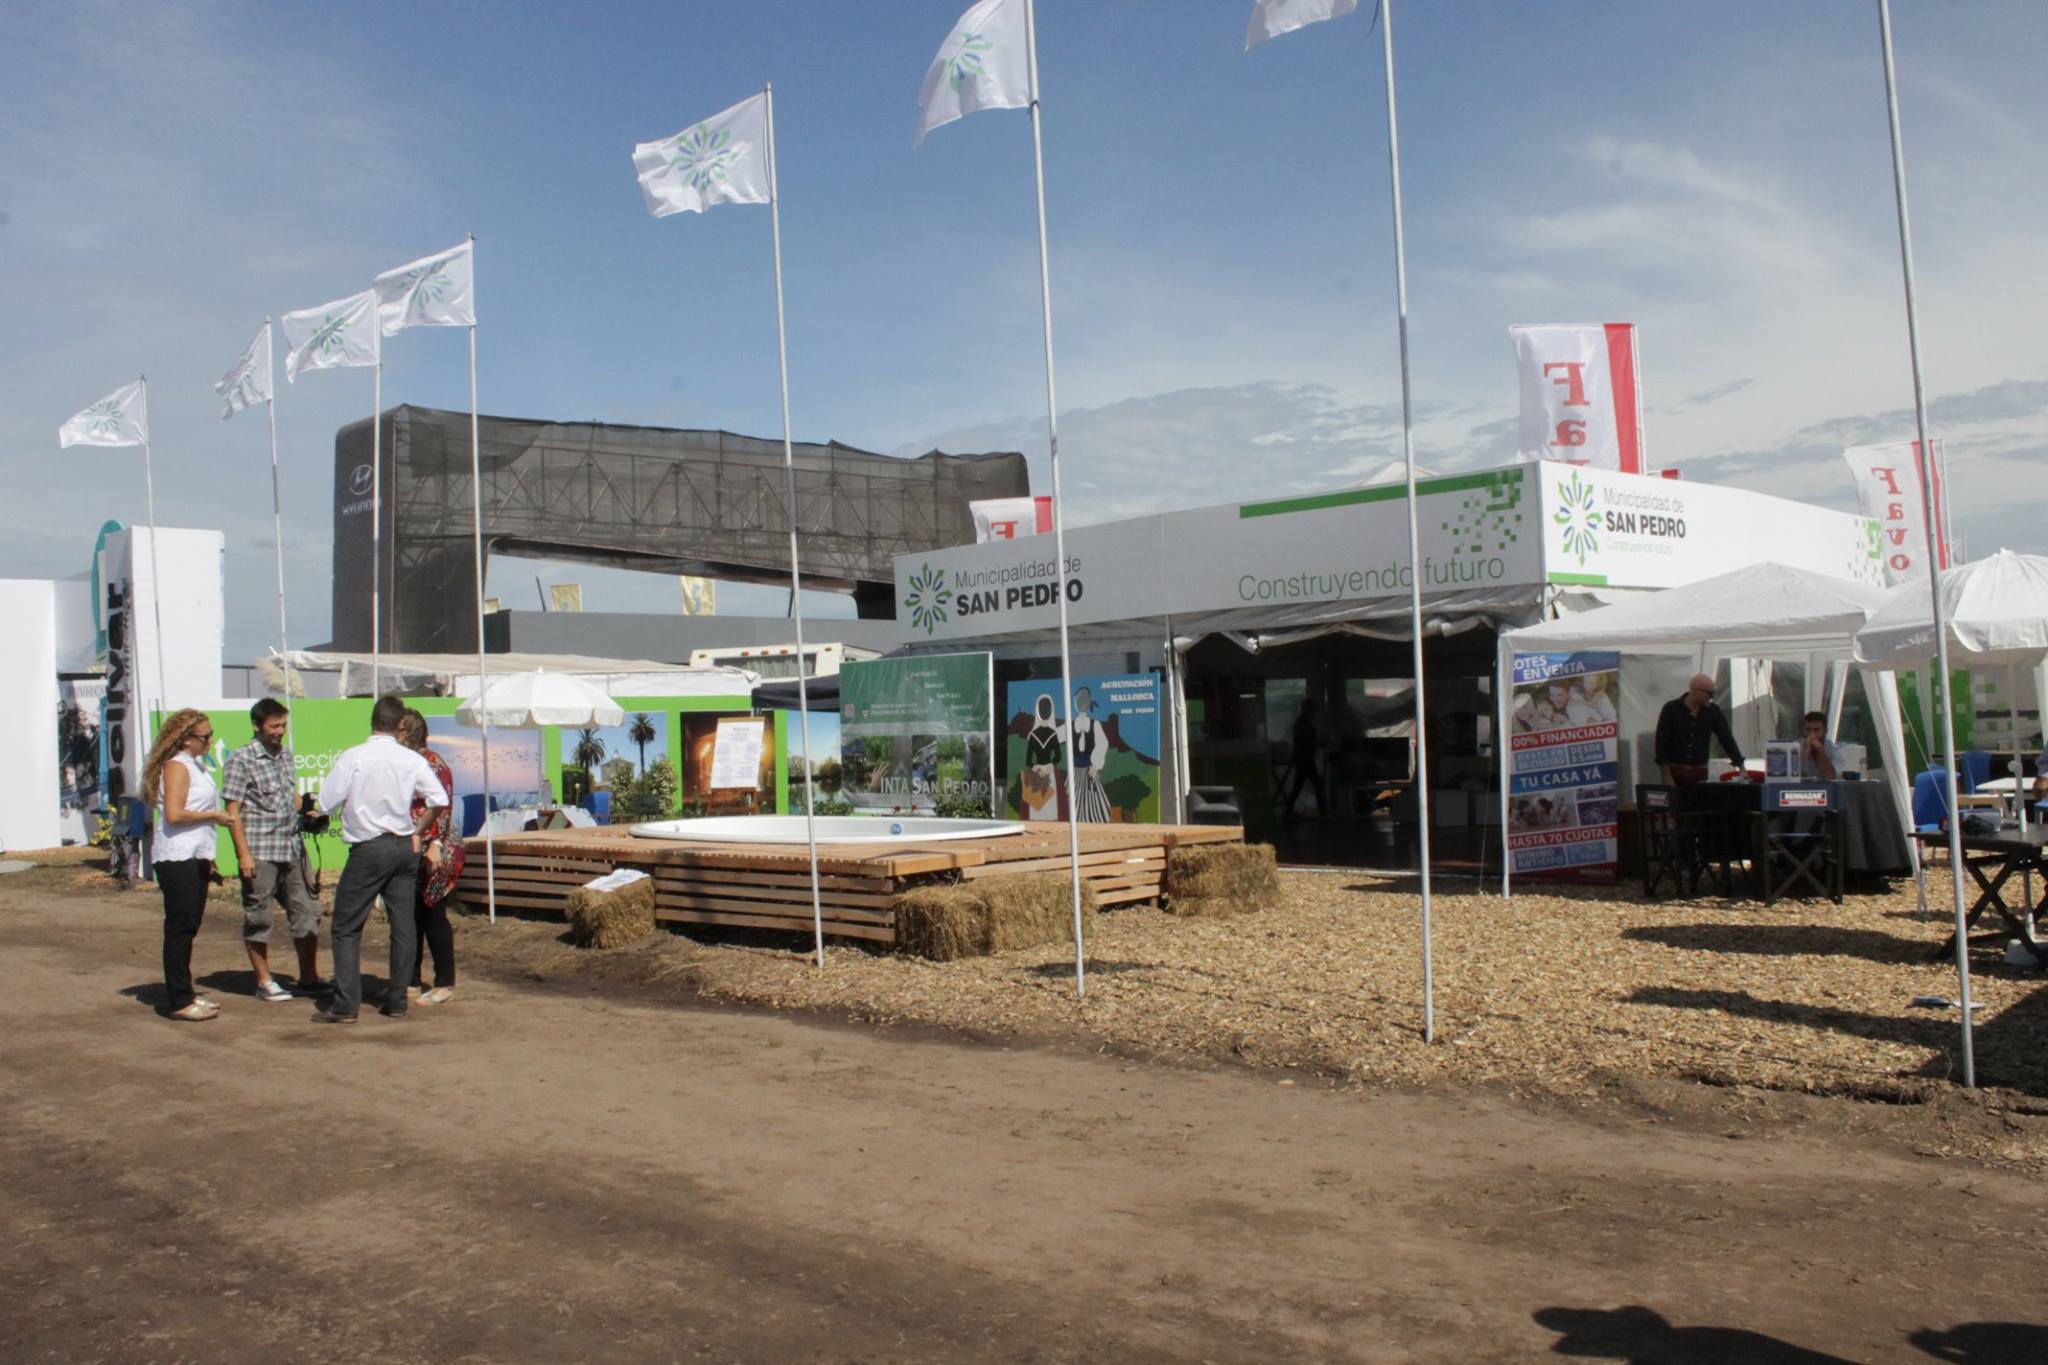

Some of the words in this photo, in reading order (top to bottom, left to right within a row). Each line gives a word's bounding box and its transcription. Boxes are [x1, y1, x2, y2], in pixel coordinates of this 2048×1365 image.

[1603, 487, 1670, 512] Municipalidad
[1672, 496, 1684, 513] de
[1606, 510, 1636, 534] SAN
[1640, 514, 1686, 539] PEDRO
[955, 557, 1056, 589] Municipalidad
[1063, 554, 1082, 575] de
[1238, 561, 1413, 601] Construyendo
[1423, 557, 1505, 586] futuro
[956, 590, 999, 617] SAN
[1523, 668, 1541, 681] EN
[1543, 661, 1586, 677] VENTA
[1512, 733, 1538, 749] 00%
[1540, 724, 1616, 745] FINANCIADO
[880, 776, 908, 794] INTA
[1520, 776, 1539, 789] TU
[1543, 771, 1580, 786] CASA
[1508, 836, 1547, 849] HASTA
[1551, 832, 1562, 843] 70
[1564, 826, 1614, 842] CUOTAS
